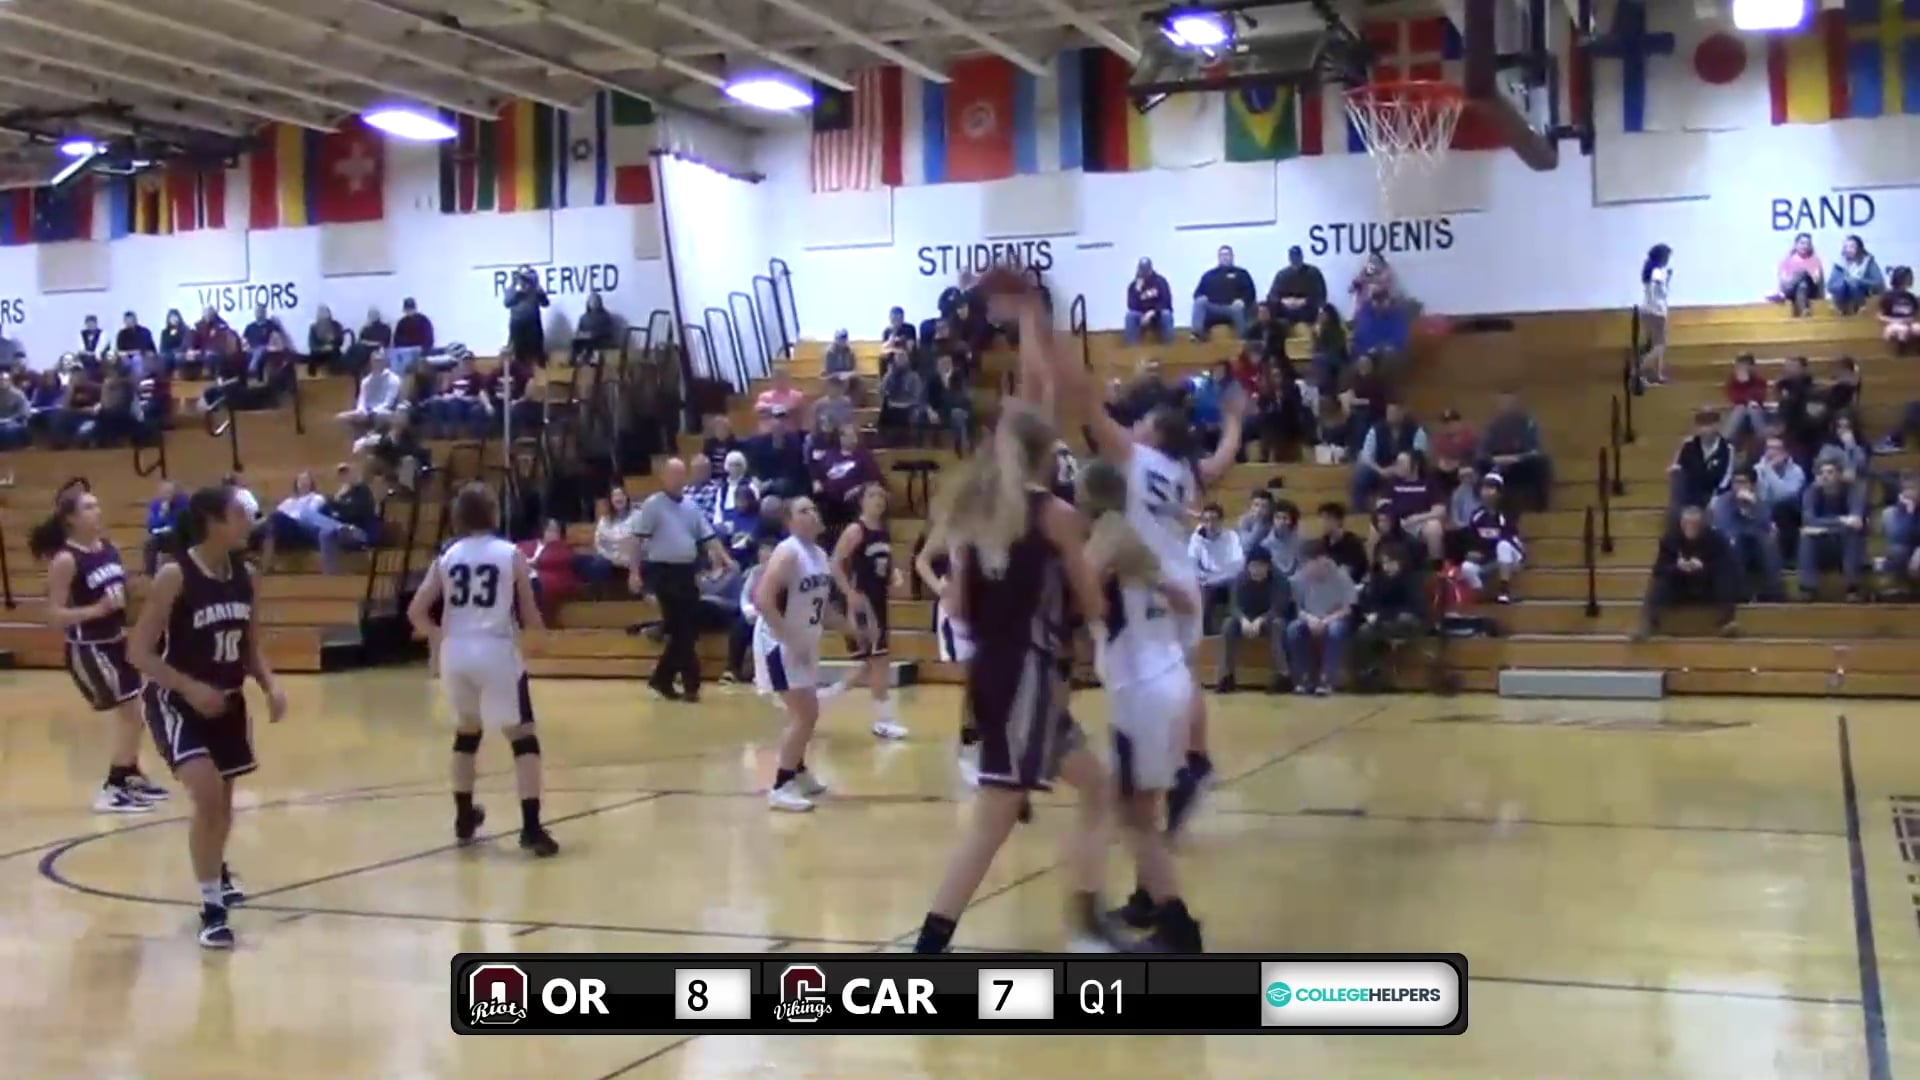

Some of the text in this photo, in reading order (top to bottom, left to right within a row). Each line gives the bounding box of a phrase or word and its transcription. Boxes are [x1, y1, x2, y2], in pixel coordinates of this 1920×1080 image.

[1772, 193, 1875, 231] BAND
[1309, 218, 1454, 256] STUDENTS
[918, 240, 1053, 276] STUDENTS
[198, 283, 298, 312] VISITORS
[494, 264, 619, 297] RERVED
[449, 563, 499, 608] 33
[809, 597, 823, 625] 3
[213, 629, 242, 662] 10
